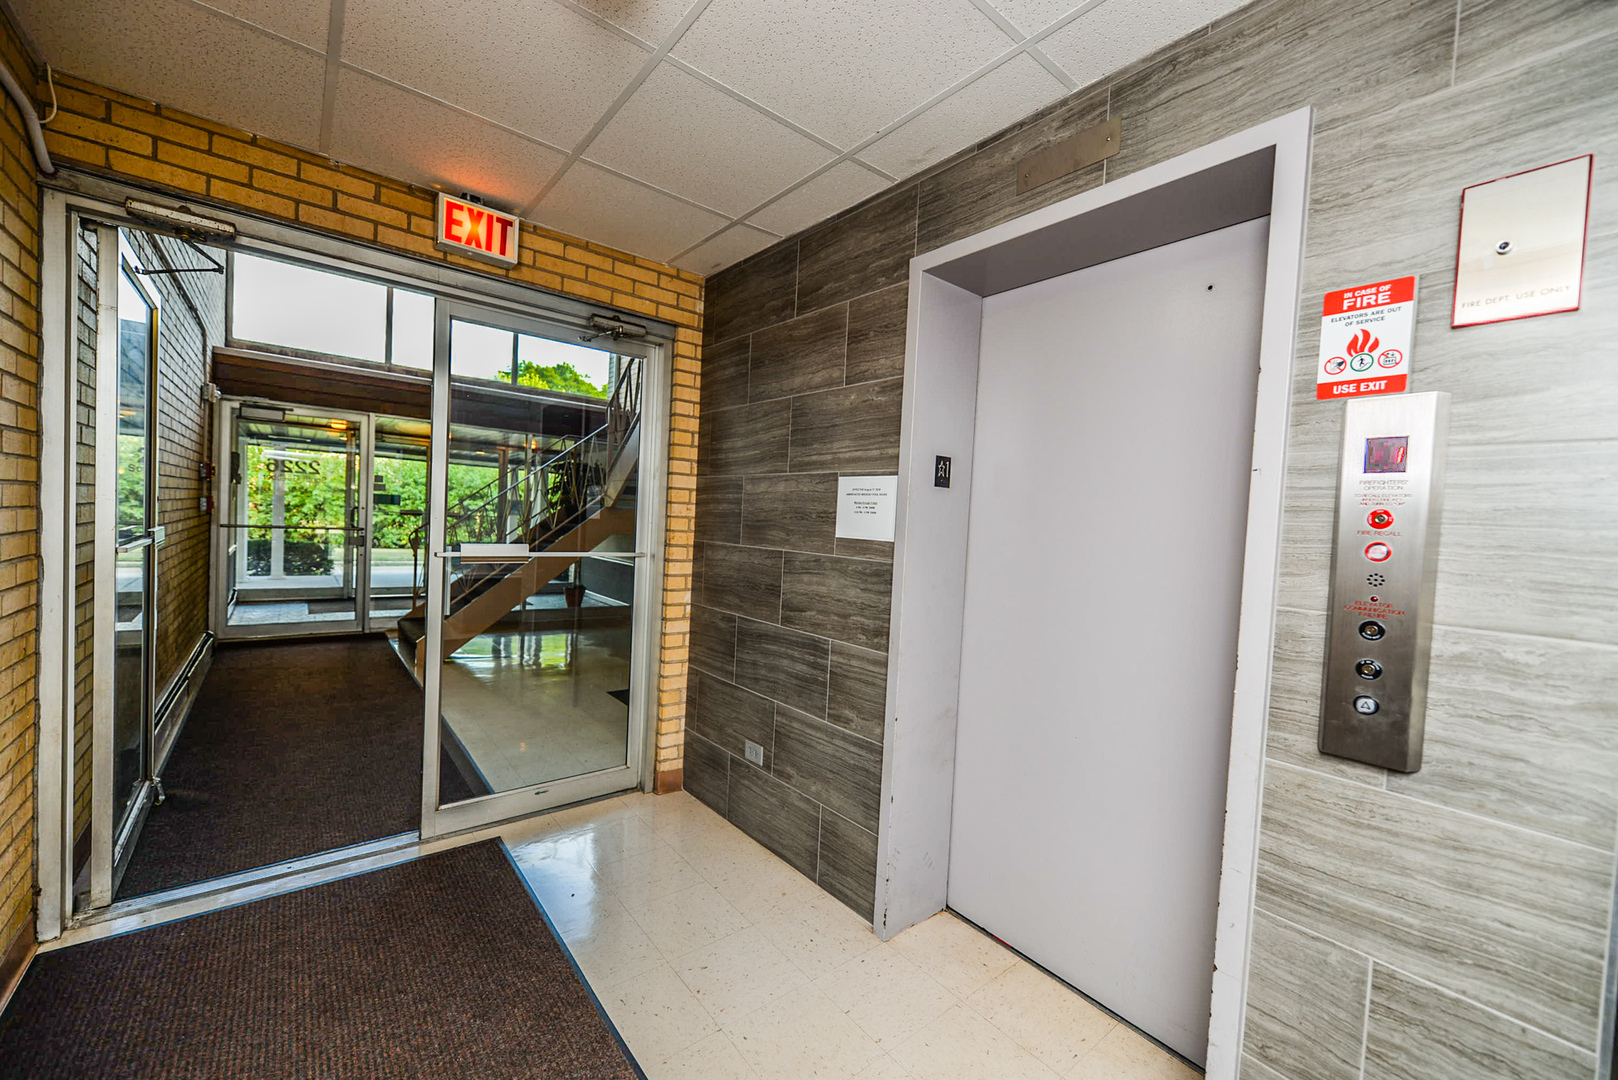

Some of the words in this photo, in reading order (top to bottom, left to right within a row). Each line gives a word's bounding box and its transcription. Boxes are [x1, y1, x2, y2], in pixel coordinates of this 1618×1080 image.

[444, 200, 513, 256] EXIT
[1343, 291, 1353, 299] IN
[1354, 286, 1377, 297] CASE
[1379, 284, 1392, 292] OF
[1461, 300, 1481, 309] FIRE
[1516, 289, 1536, 300] USE
[1540, 285, 1571, 296] ONLY
[1342, 291, 1391, 311] FIRE
[1330, 312, 1369, 324] ELEVATORS
[1387, 306, 1402, 314] OUT
[1355, 315, 1386, 326] SERVICE
[1332, 383, 1358, 395] USE
[1360, 380, 1388, 392] EXIT
[1354, 600, 1394, 609] ELEVATOR
